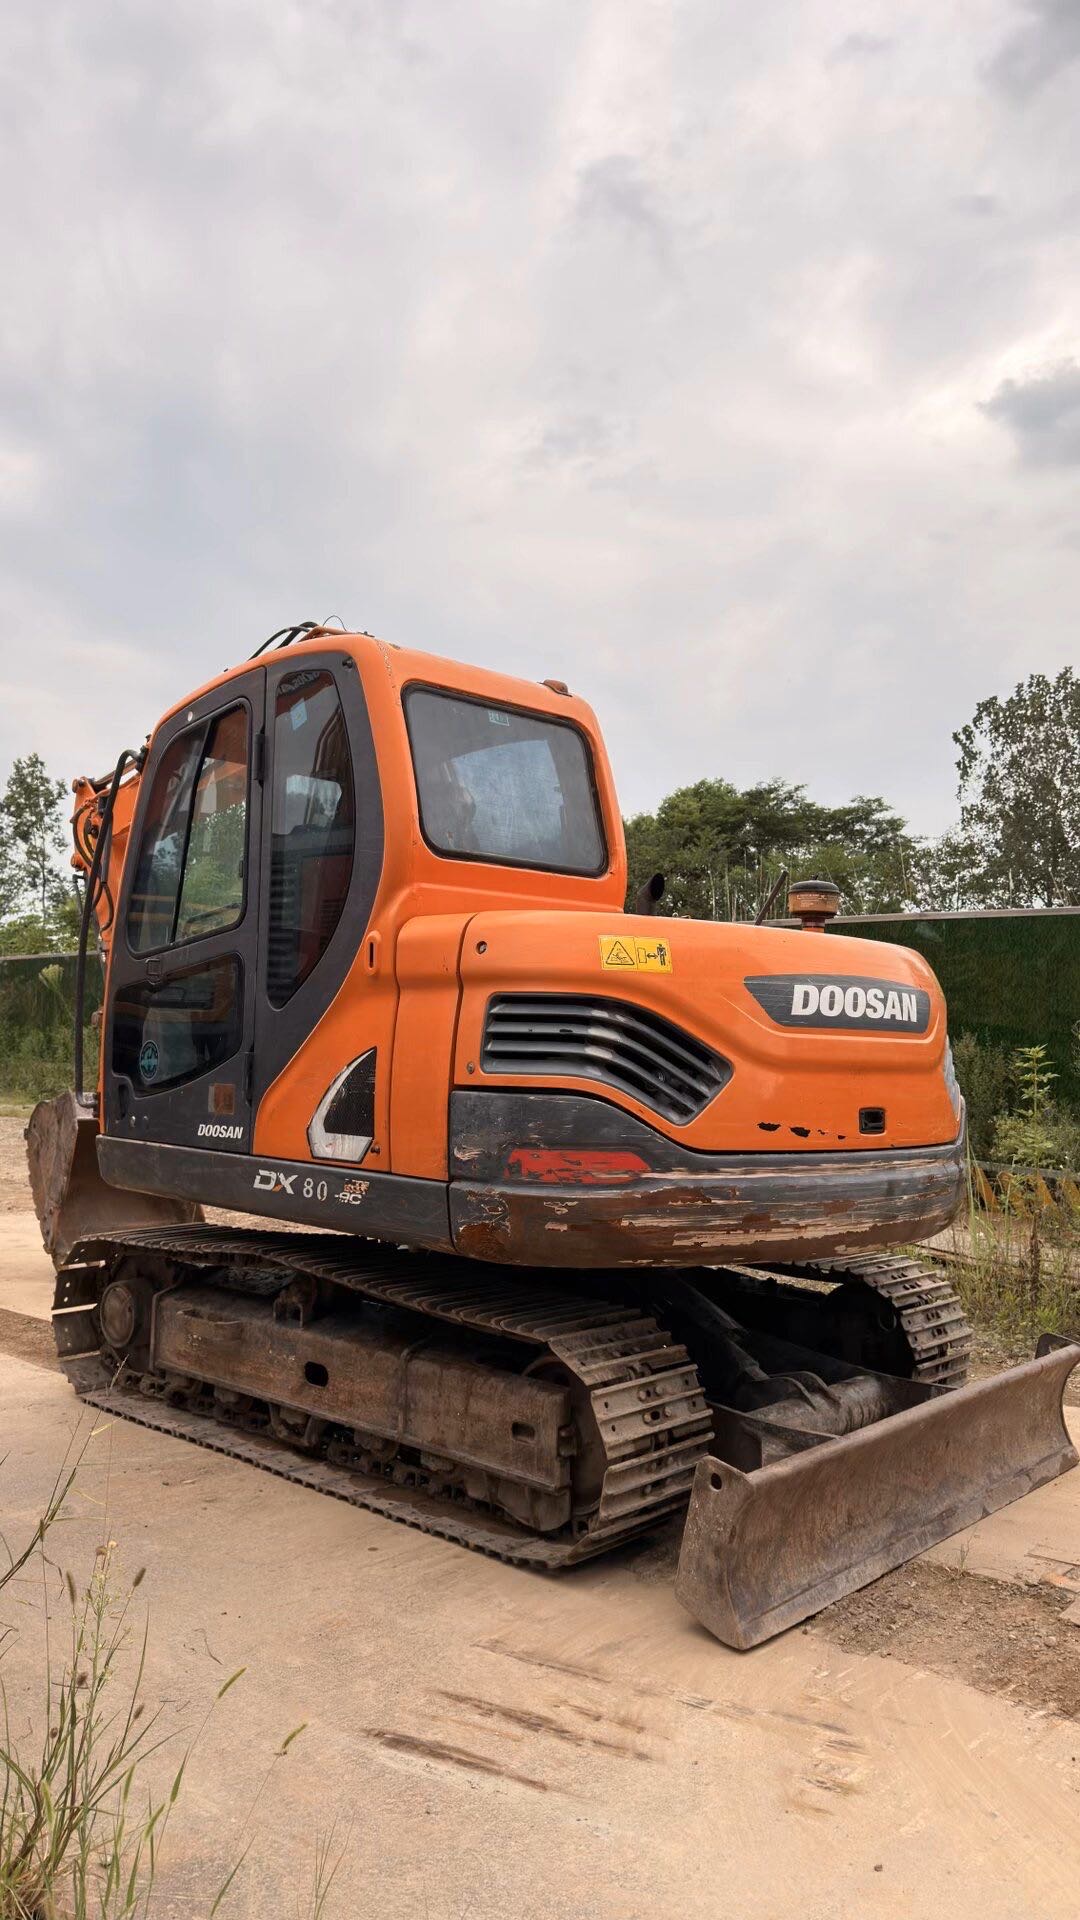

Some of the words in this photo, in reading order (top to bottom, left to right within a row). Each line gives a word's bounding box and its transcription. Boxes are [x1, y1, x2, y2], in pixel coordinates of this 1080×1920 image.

[791, 984, 917, 1023] DOOSAN
[197, 1123, 243, 1139] DOOSAN
[253, 1169, 298, 1195] DX
[303, 1178, 328, 1201] 80
